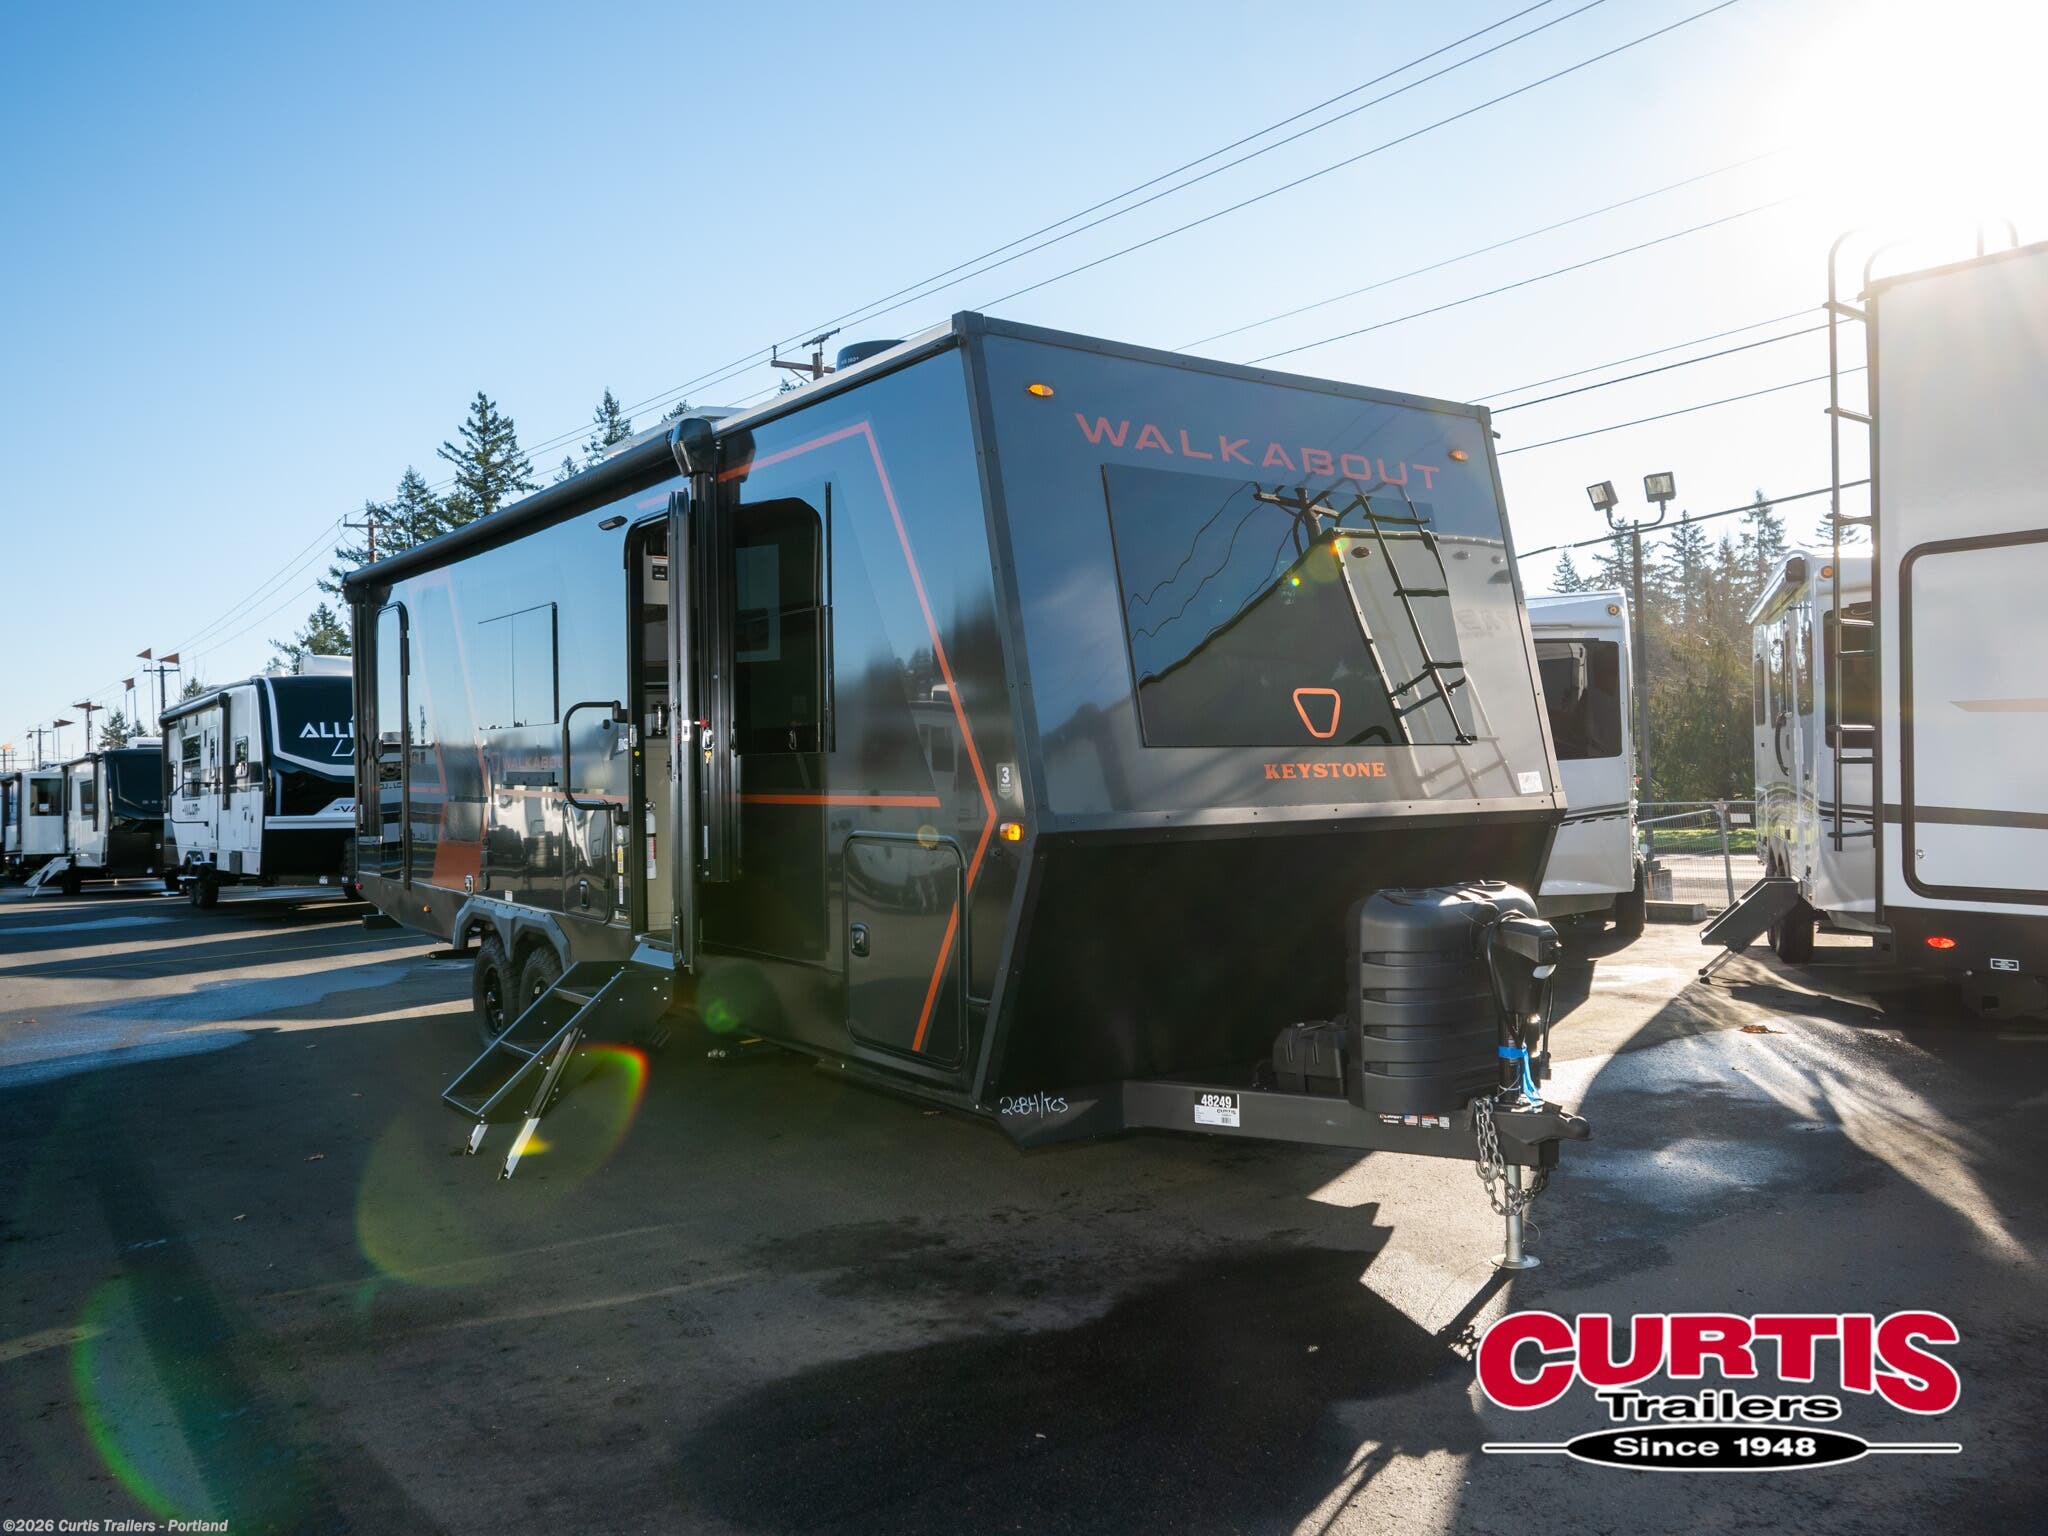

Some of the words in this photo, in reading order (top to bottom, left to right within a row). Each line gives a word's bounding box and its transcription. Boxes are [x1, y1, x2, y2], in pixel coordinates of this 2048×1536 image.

[1075, 412, 1440, 489] WALKABOUT
[1001, 766, 1010, 784] 3
[1264, 762, 1387, 779] KEYSTONE
[1200, 1094, 1232, 1109] 48249
